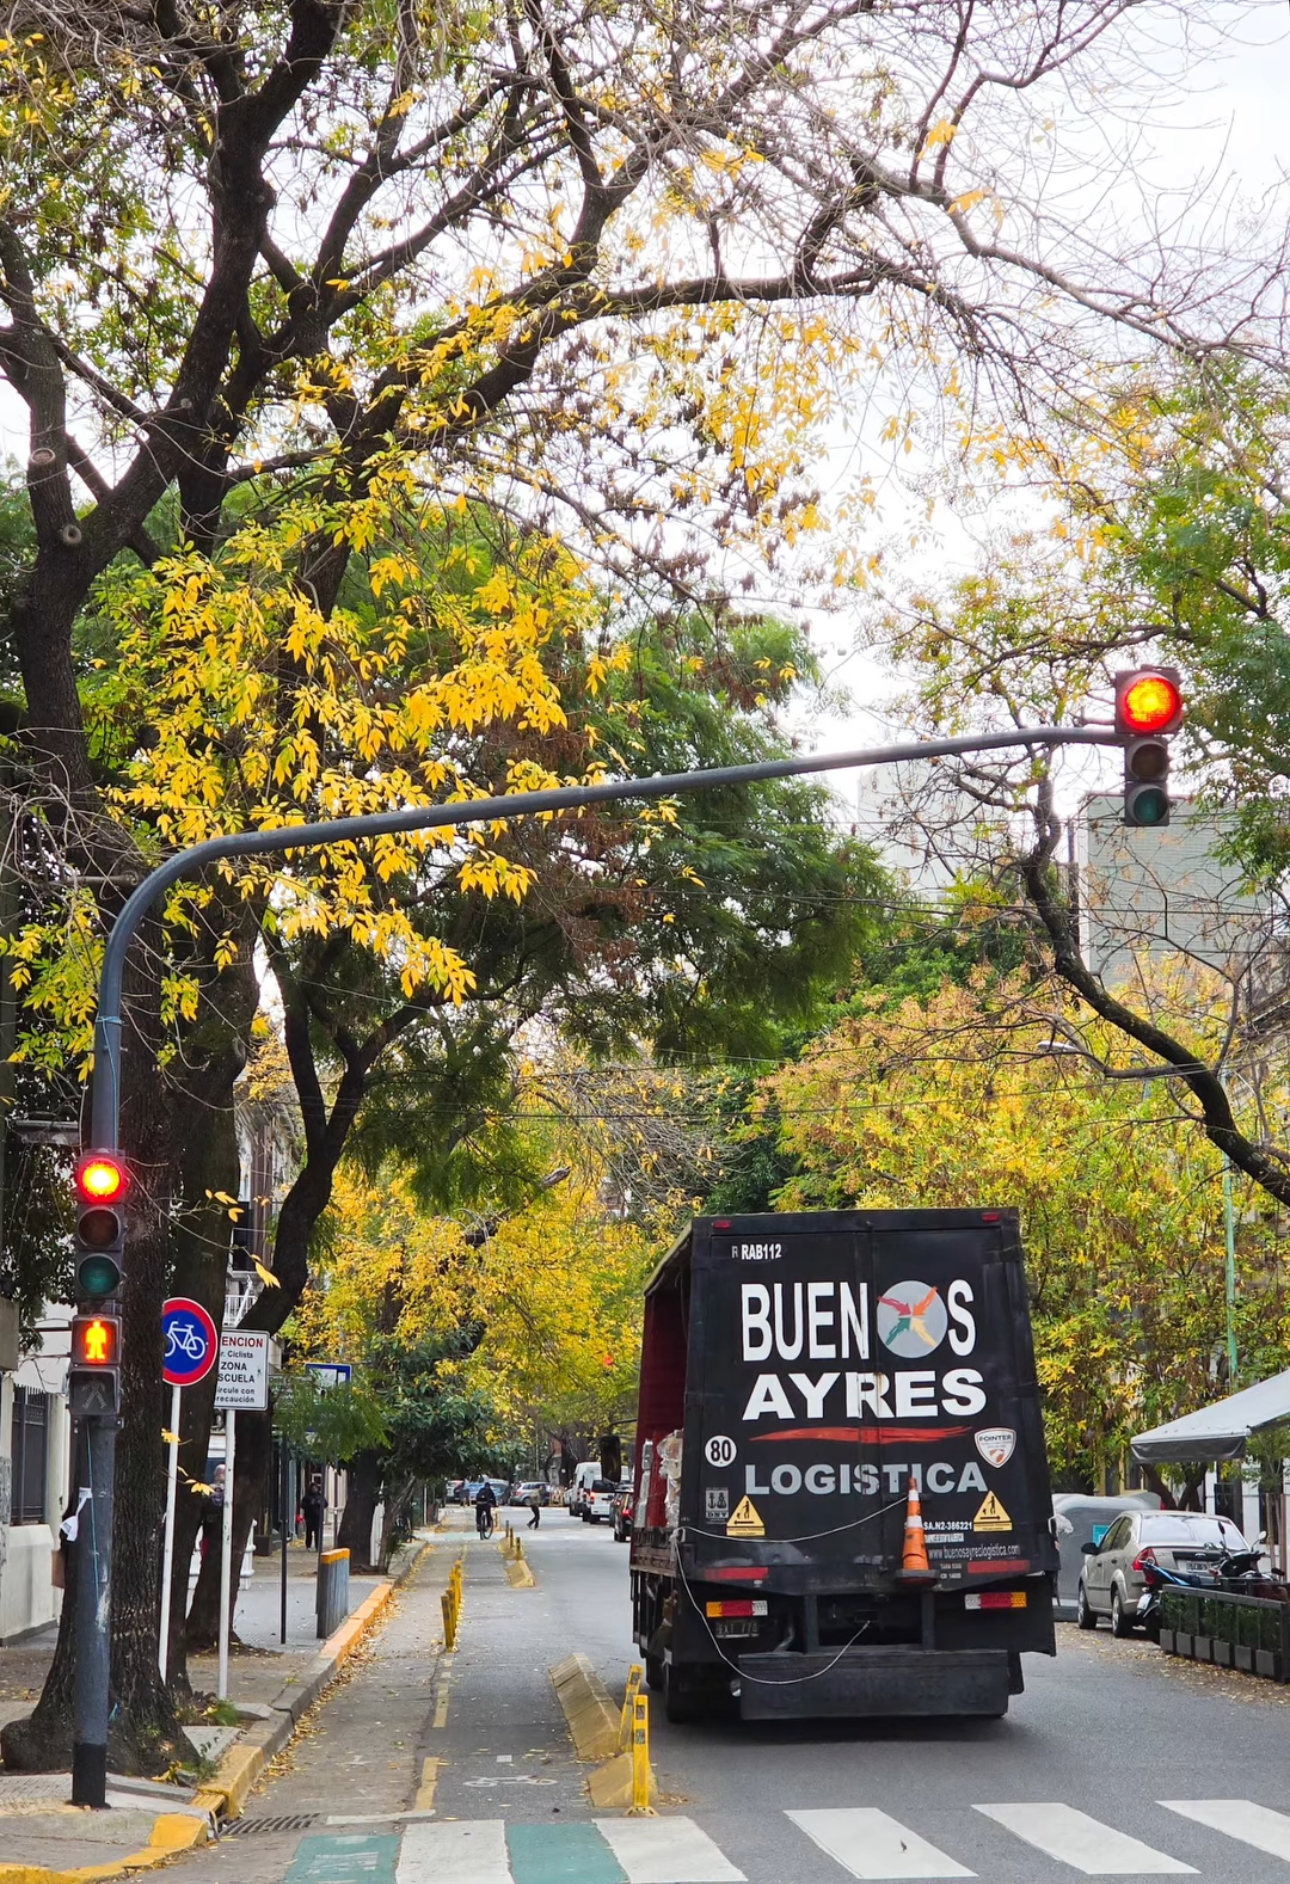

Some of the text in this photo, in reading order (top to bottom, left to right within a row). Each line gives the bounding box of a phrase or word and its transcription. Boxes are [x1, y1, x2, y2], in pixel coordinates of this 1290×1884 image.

[741, 1243, 782, 1260] RAB112
[221, 1336, 264, 1348] ENCION
[220, 1361, 247, 1371] ZONA
[217, 1373, 255, 1383] SCUELA
[742, 1368, 987, 1421] AYRES
[710, 1439, 732, 1462] 80
[745, 1461, 989, 1495] LOGISTICA
